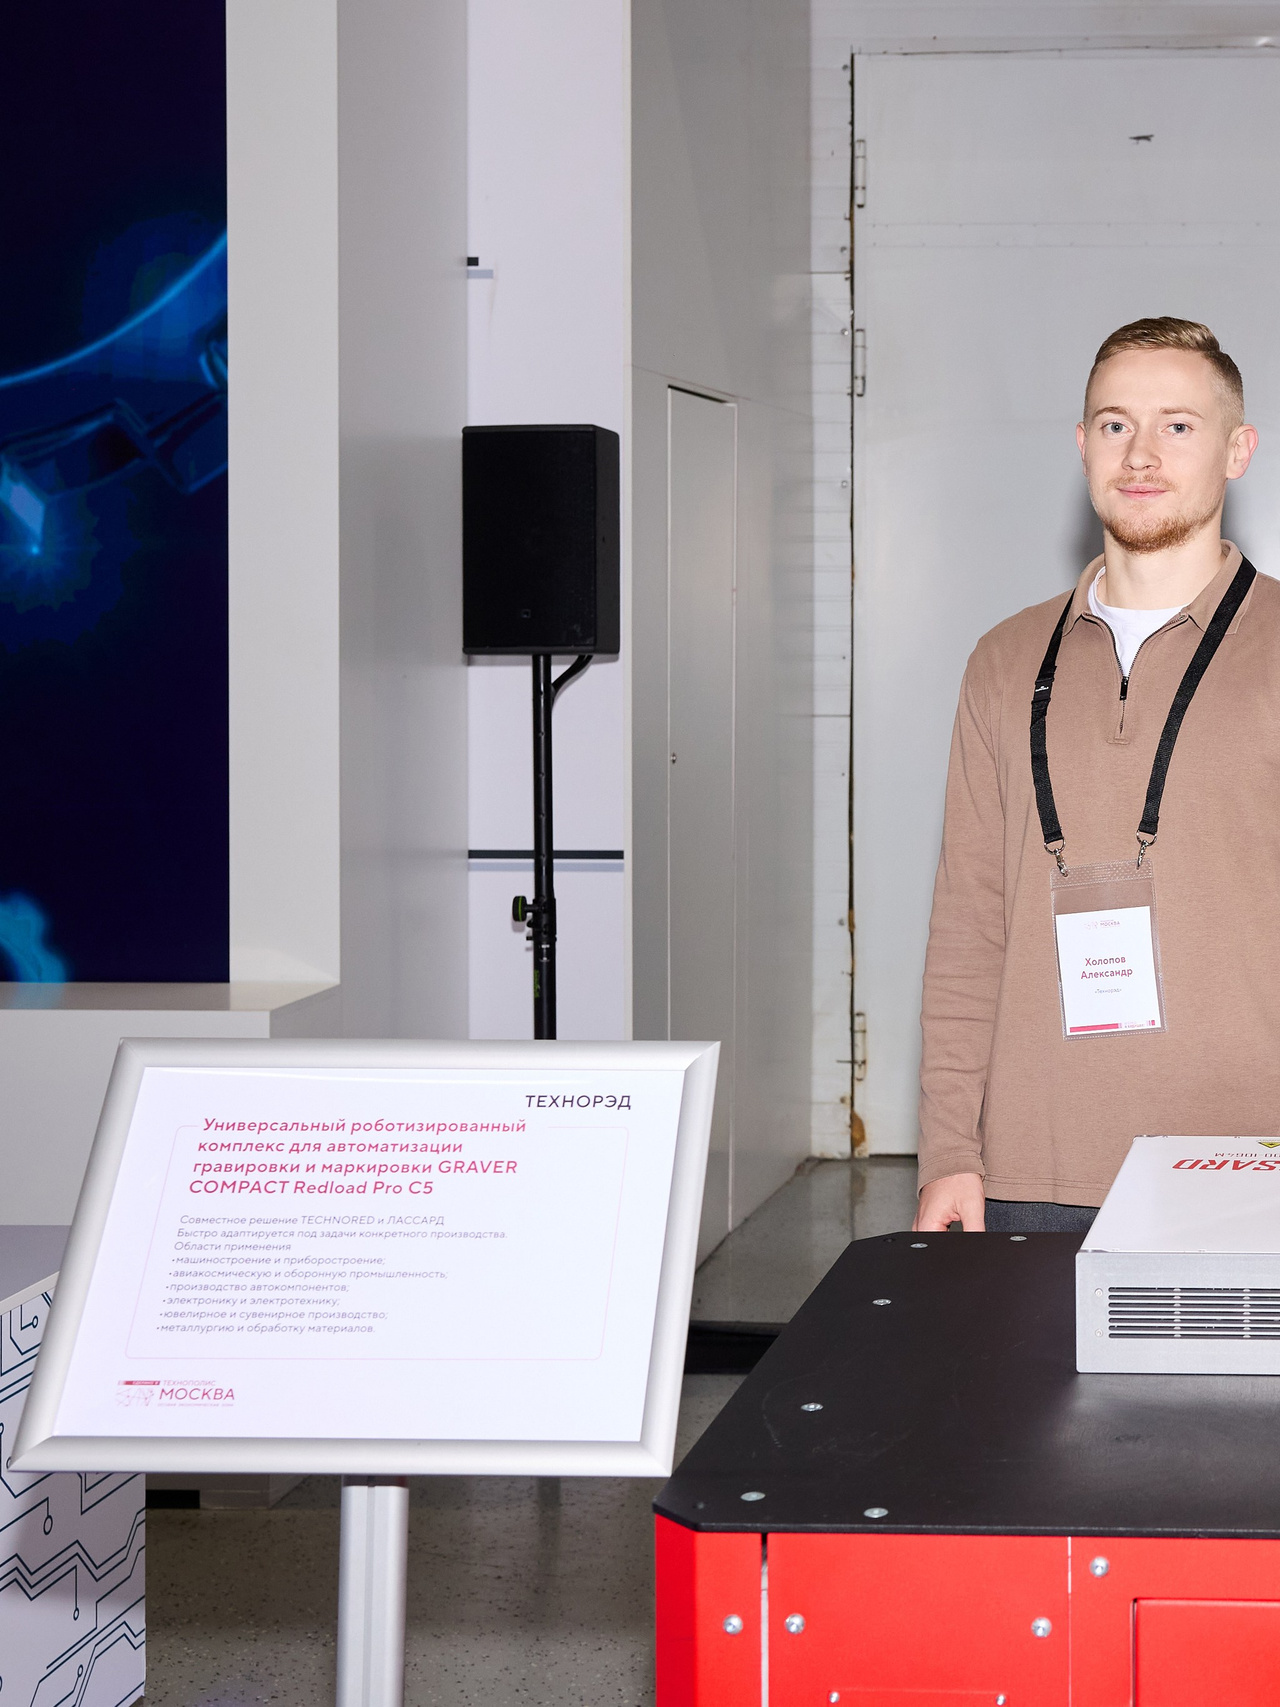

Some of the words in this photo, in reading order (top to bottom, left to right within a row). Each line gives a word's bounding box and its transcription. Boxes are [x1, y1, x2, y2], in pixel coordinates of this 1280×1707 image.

[1084, 956, 1126, 967] Холопов
[1080, 968, 1133, 980] Александр
[525, 1094, 632, 1110] ТЕХНОРЭД
[203, 1118, 346, 1135] Универсальный
[350, 1118, 527, 1135] роботизированный
[198, 1142, 285, 1152] комплекс
[289, 1142, 321, 1154] для
[326, 1142, 463, 1154] автоматизации
[193, 1162, 300, 1176] гравировки
[305, 1163, 316, 1173] и
[321, 1162, 432, 1176] маркировки
[437, 1160, 518, 1174] GRAVER
[189, 1180, 290, 1194] COMPACT
[293, 1181, 367, 1194] Redload
[372, 1181, 403, 1194] Pro
[408, 1181, 434, 1195] C5
[180, 1215, 247, 1225] Совместное
[249, 1216, 298, 1226] решение
[301, 1215, 375, 1225] TECHNORED
[387, 1215, 445, 1226] ЛАССАРД
[177, 1228, 218, 1240] Быстро
[220, 1229, 295, 1240] адаптируется
[297, 1230, 317, 1239] под
[319, 1230, 356, 1239] задачи
[359, 1230, 428, 1240] конкретного
[430, 1231, 508, 1240] производства.
[174, 1241, 221, 1251] Области
[224, 1243, 291, 1252] применения
[283, 1255, 386, 1266] приборостроение;
[284, 1269, 347, 1280] оборонную
[349, 1270, 449, 1280] промышленность;
[250, 1283, 350, 1293] автокомпонентов;
[249, 1297, 341, 1307] электротехнику;
[239, 1311, 306, 1321] сувенирное
[308, 1311, 389, 1321] производство;
[246, 1323, 306, 1334] обработку
[307, 1325, 376, 1334] материалов.
[159, 1388, 235, 1400] МОСКВА
